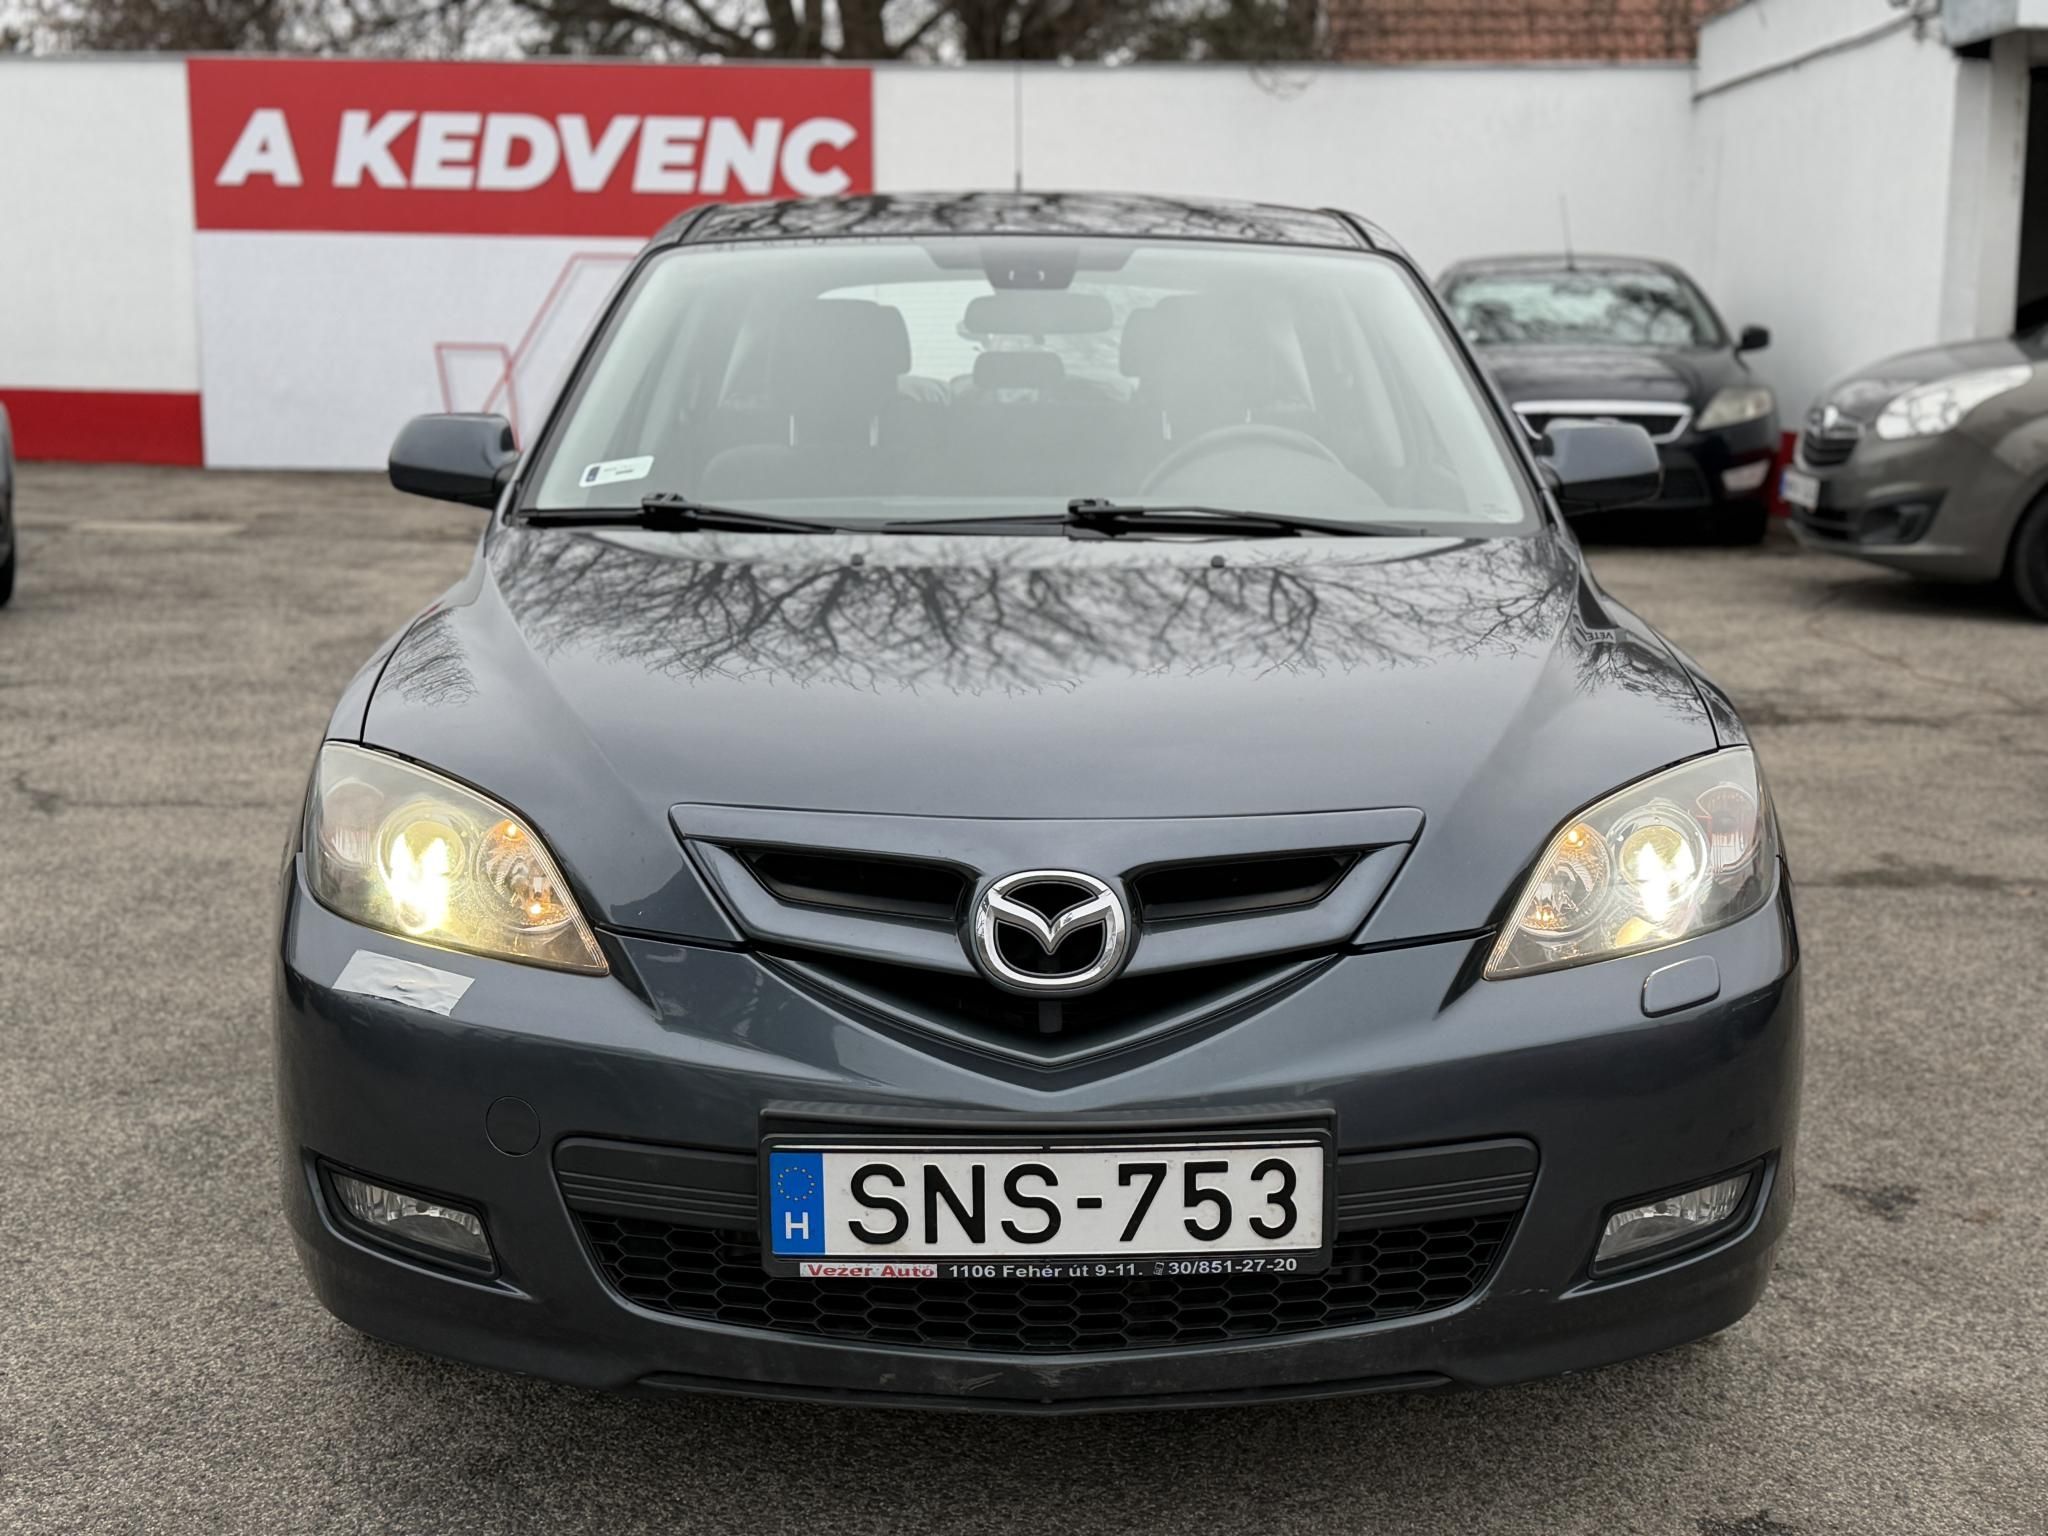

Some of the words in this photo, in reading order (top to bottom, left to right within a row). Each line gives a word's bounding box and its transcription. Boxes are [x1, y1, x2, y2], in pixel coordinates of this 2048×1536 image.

[216, 109, 302, 186] A
[333, 110, 858, 196] KEDVENC
[785, 1211, 809, 1240] H
[848, 1158, 1297, 1244] SNS-753
[949, 1265, 996, 1278] 1106
[1002, 1264, 1063, 1278] Fehér
[1069, 1264, 1089, 1277] út
[1095, 1263, 1143, 1277] 9-11.
[1168, 1258, 1297, 1275] 30/851-27-20
